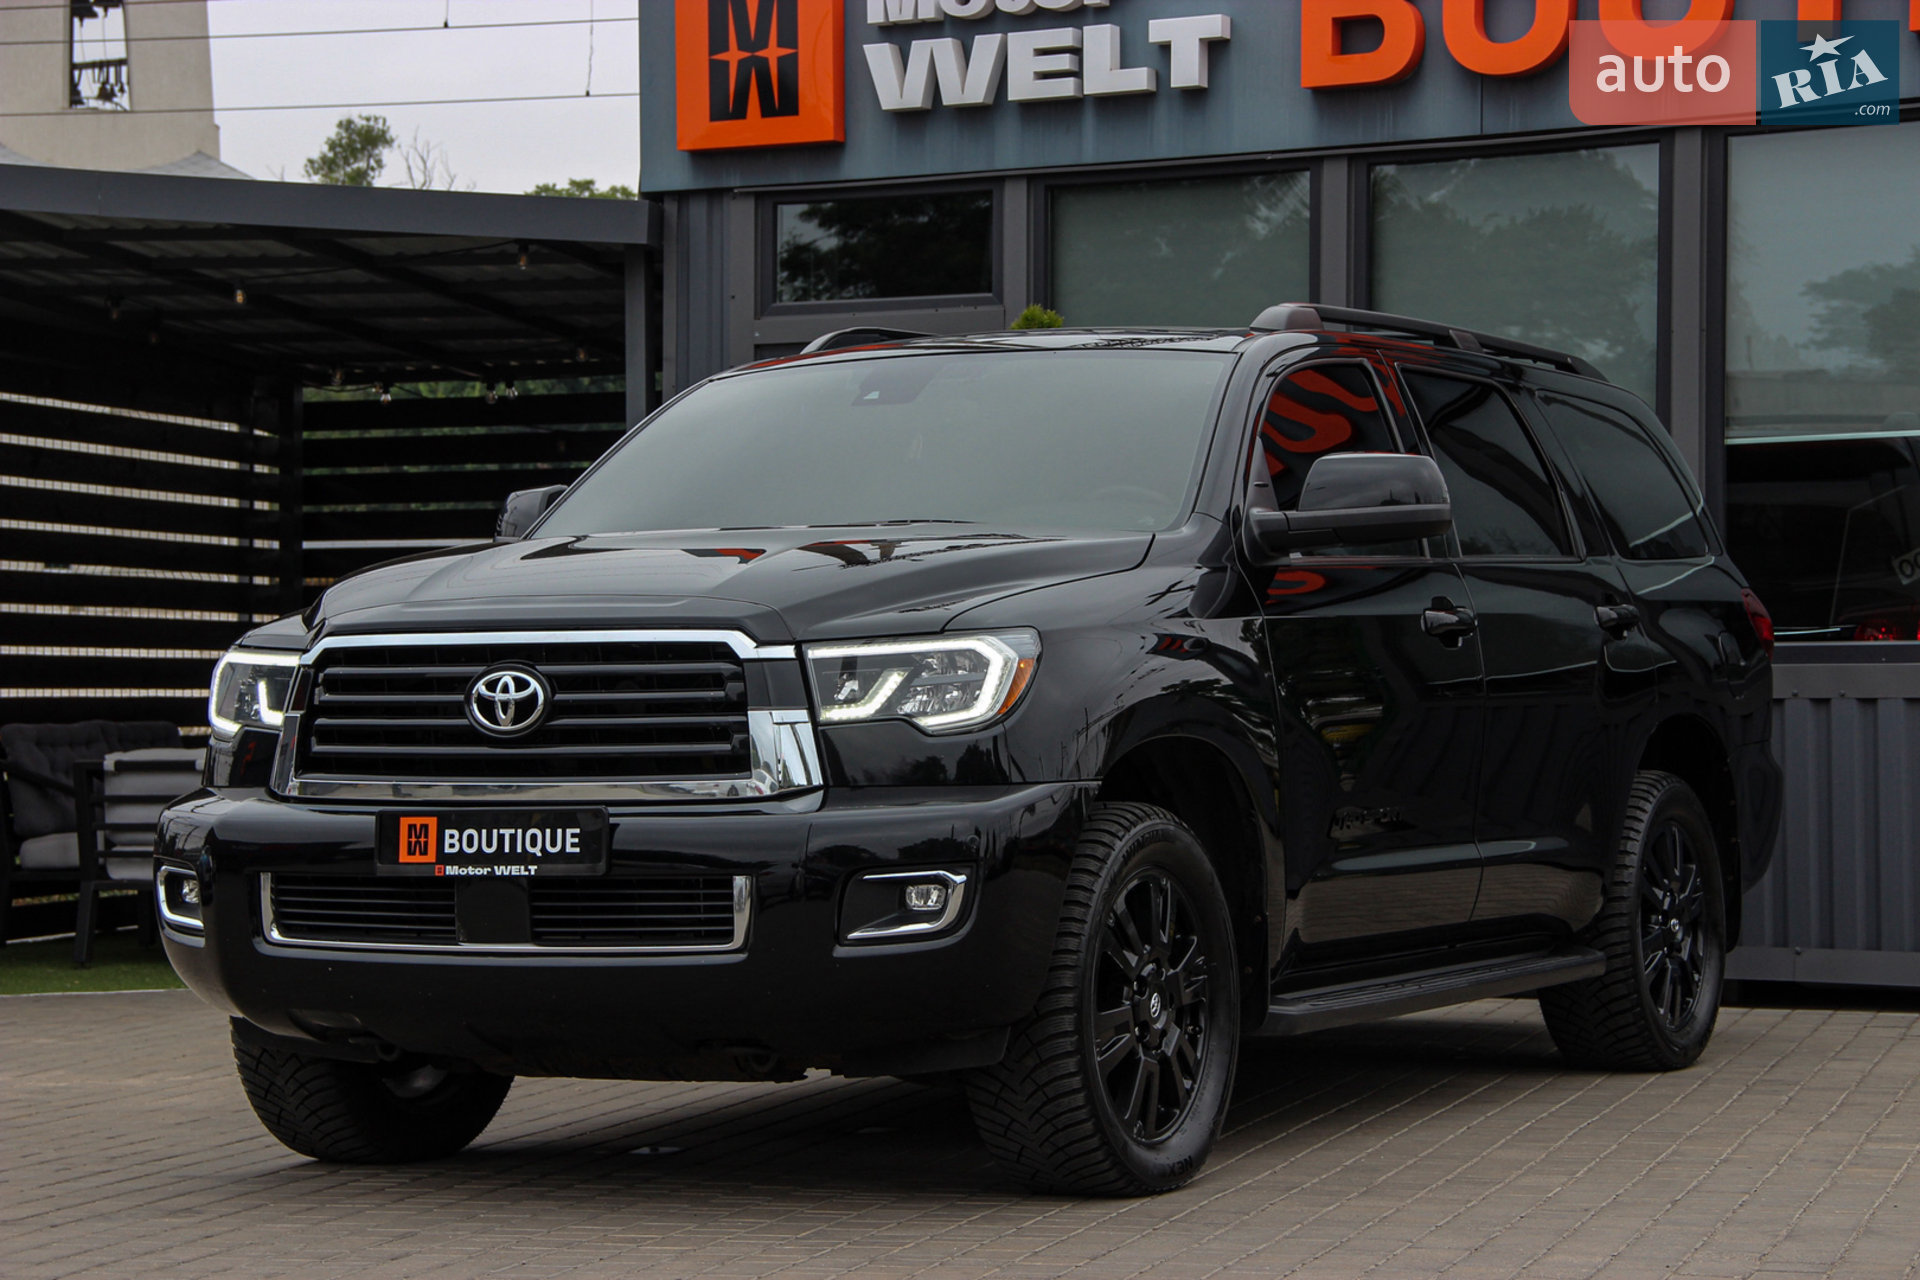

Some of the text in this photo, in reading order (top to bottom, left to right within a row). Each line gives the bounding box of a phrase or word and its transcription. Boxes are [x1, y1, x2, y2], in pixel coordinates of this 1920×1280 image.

[863, 14, 1231, 112] WELT
[443, 828, 581, 857] BOUTIQUE
[445, 865, 537, 876] Motor WELT
